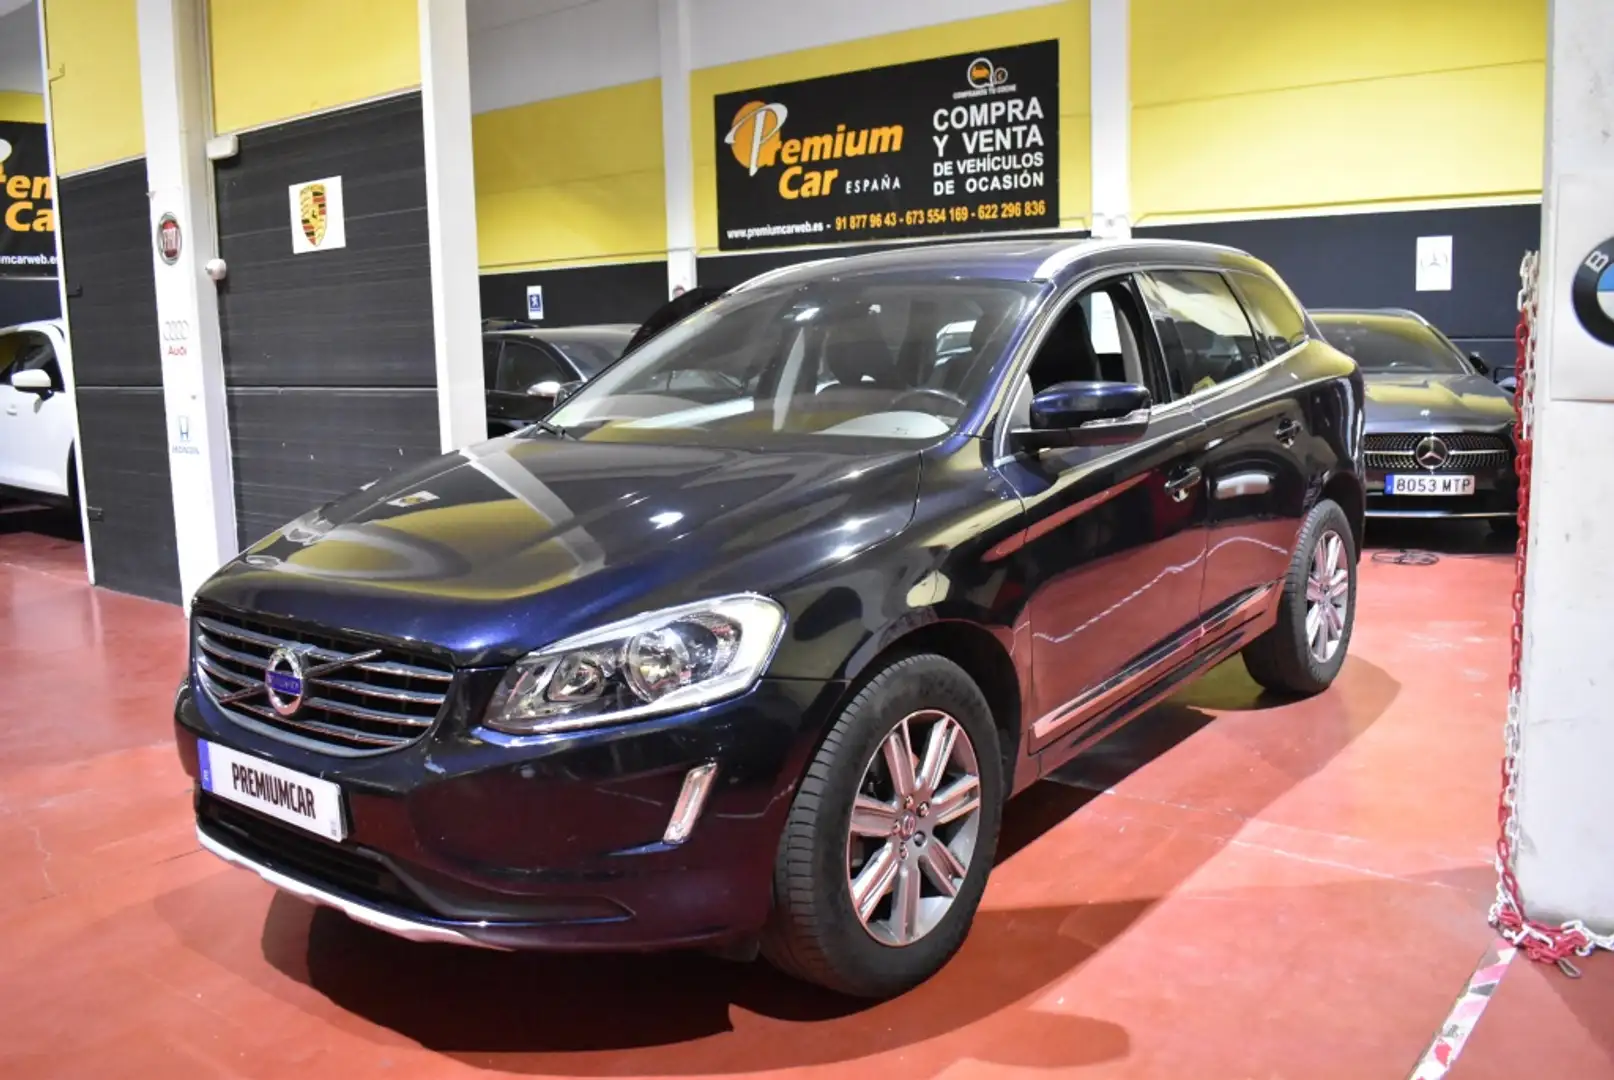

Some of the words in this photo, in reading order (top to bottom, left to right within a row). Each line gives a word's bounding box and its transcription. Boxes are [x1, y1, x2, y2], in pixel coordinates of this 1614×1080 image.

[933, 96, 1045, 132] COMPRA
[724, 101, 904, 177] Premium
[932, 134, 949, 158] Y
[962, 124, 1045, 154] VENTA
[933, 161, 953, 177] DE
[957, 152, 1044, 174] VEHÍCULOS
[778, 165, 839, 200] Car
[845, 174, 901, 194] ESPAÑA
[933, 180, 955, 196] DE
[965, 170, 1044, 193] OCASIÓN
[726, 221, 824, 240] www.premiumcarweb.es
[835, 216, 847, 231] 91
[849, 214, 867, 230] 877
[869, 213, 882, 228] 96
[884, 212, 897, 227] 43
[905, 210, 925, 226] 673
[927, 208, 947, 224] 554
[950, 206, 969, 222] 169
[977, 204, 999, 220] 622
[1001, 202, 1022, 218] 296
[1024, 200, 1046, 216] 836
[168, 345, 187, 356] Audi
[1396, 478, 1437, 493] 8053
[1442, 478, 1470, 493] MTP
[231, 762, 317, 820] PREMIUMCAR
